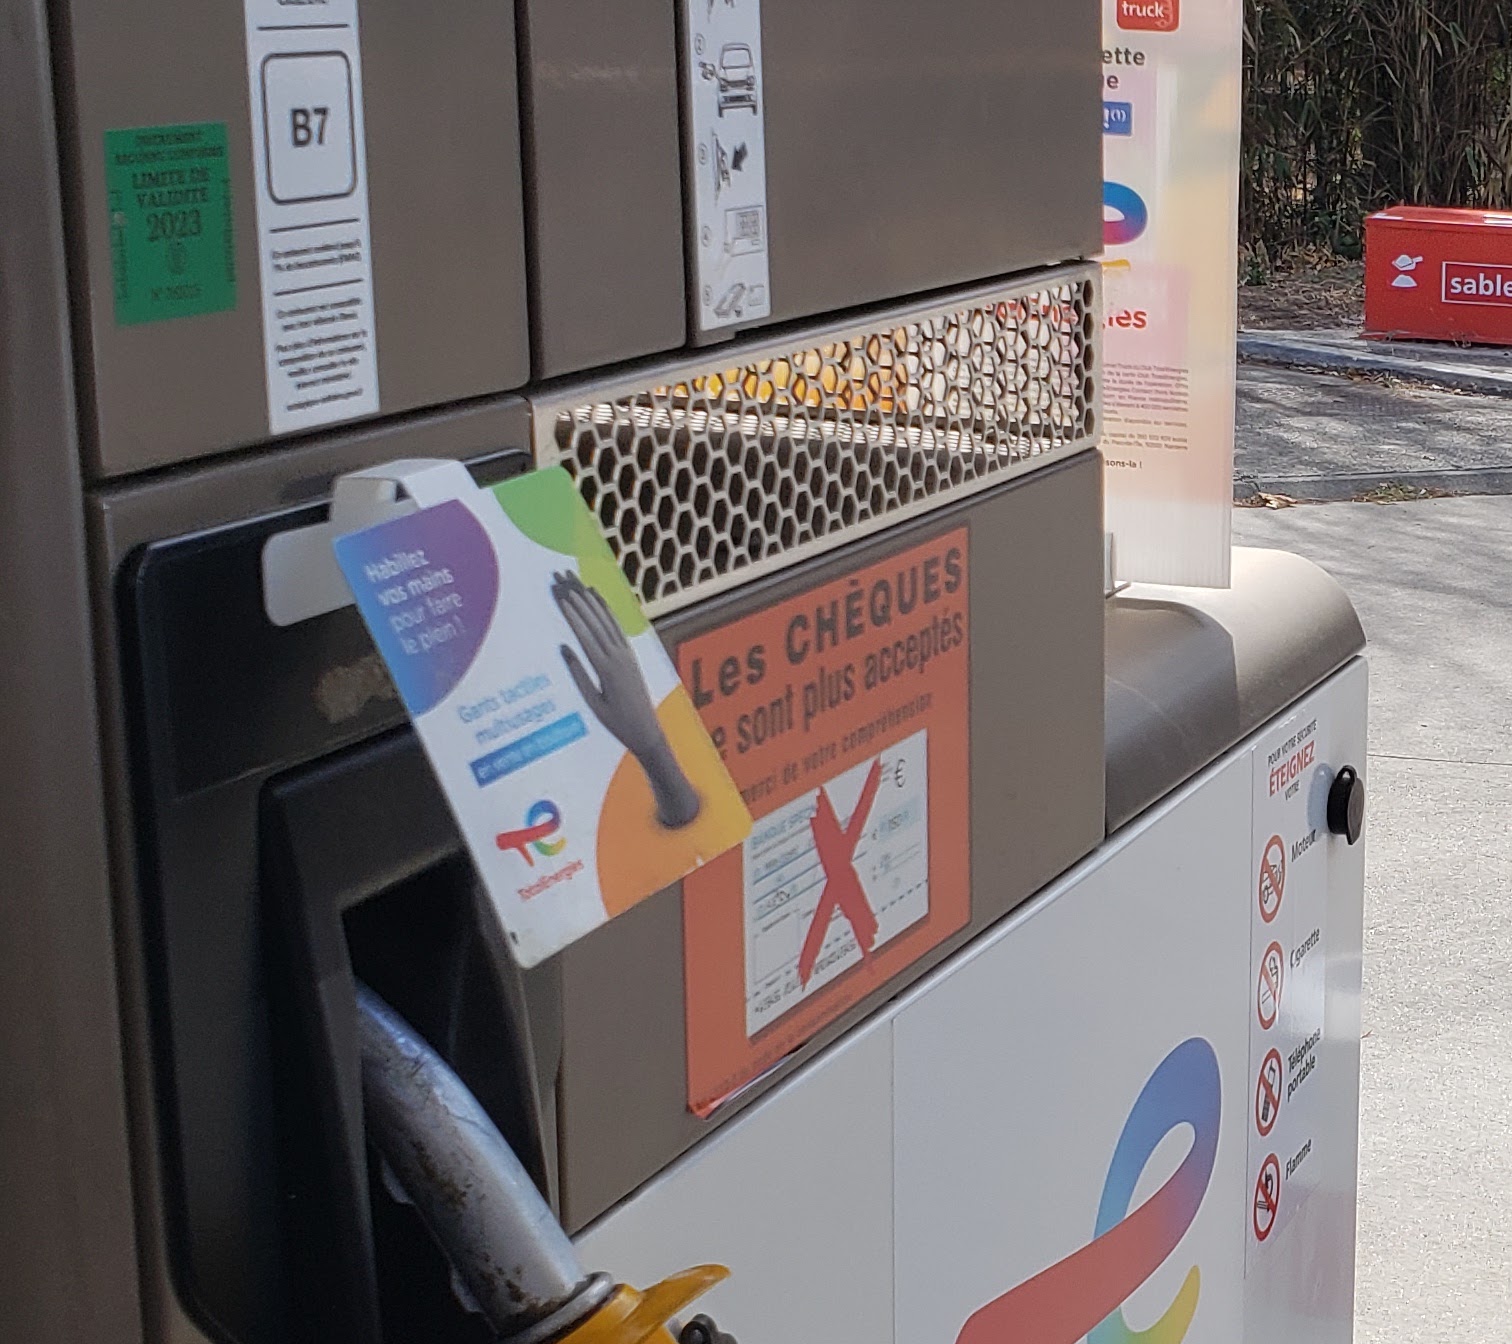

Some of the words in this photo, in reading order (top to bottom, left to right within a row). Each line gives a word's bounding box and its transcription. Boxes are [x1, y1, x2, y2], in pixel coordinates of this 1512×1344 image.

[1122, 1, 1165, 18] truck
[290, 108, 330, 147] B7
[146, 209, 203, 243] 2023
[407, 568, 455, 596] mains
[691, 644, 766, 708] Les
[785, 546, 962, 666] CHÈQUES
[736, 683, 794, 754] sont
[802, 662, 856, 733] plus
[864, 607, 964, 691] acceptés
[1267, 747, 1281, 768] POUR
[1282, 735, 1297, 756] VOTRE
[1269, 739, 1315, 797] ÉTEIGNEZ
[1285, 780, 1300, 801] VOTRE
[1291, 828, 1317, 863] Moteur
[1289, 927, 1321, 969] Cigarette
[1287, 1027, 1321, 1074] Téléphone
[1287, 1054, 1316, 1103] portable
[1285, 1139, 1312, 1181] Flamme
